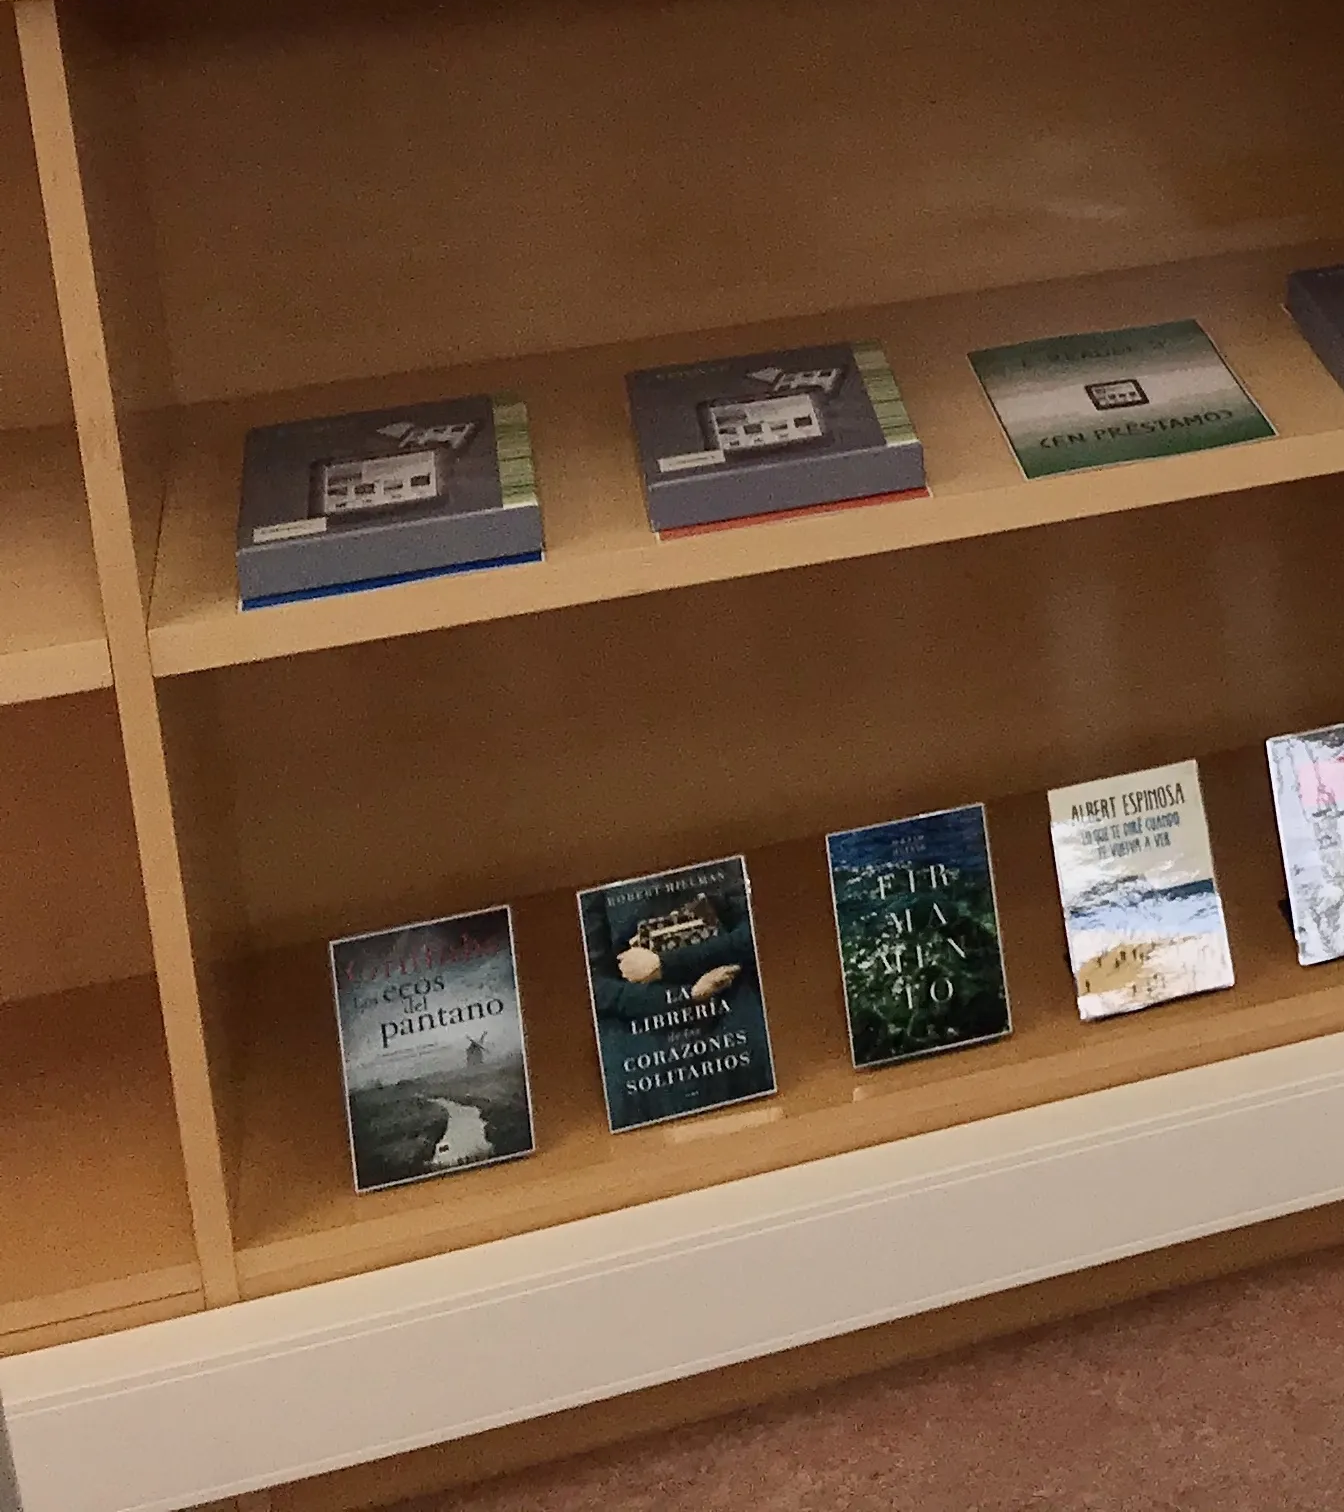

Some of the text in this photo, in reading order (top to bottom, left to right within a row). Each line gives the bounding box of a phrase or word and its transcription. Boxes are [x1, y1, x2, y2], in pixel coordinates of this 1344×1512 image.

[1071, 782, 1186, 824] ALBERT ESPINOSA
[382, 974, 445, 1003] ecos
[403, 995, 428, 1014] del
[666, 988, 691, 1005] LA
[380, 997, 505, 1049] pantano
[630, 995, 733, 1035] LIBRERÍA
[623, 1030, 748, 1073] CORAZONES
[626, 1052, 751, 1095] SOLITARIOS
